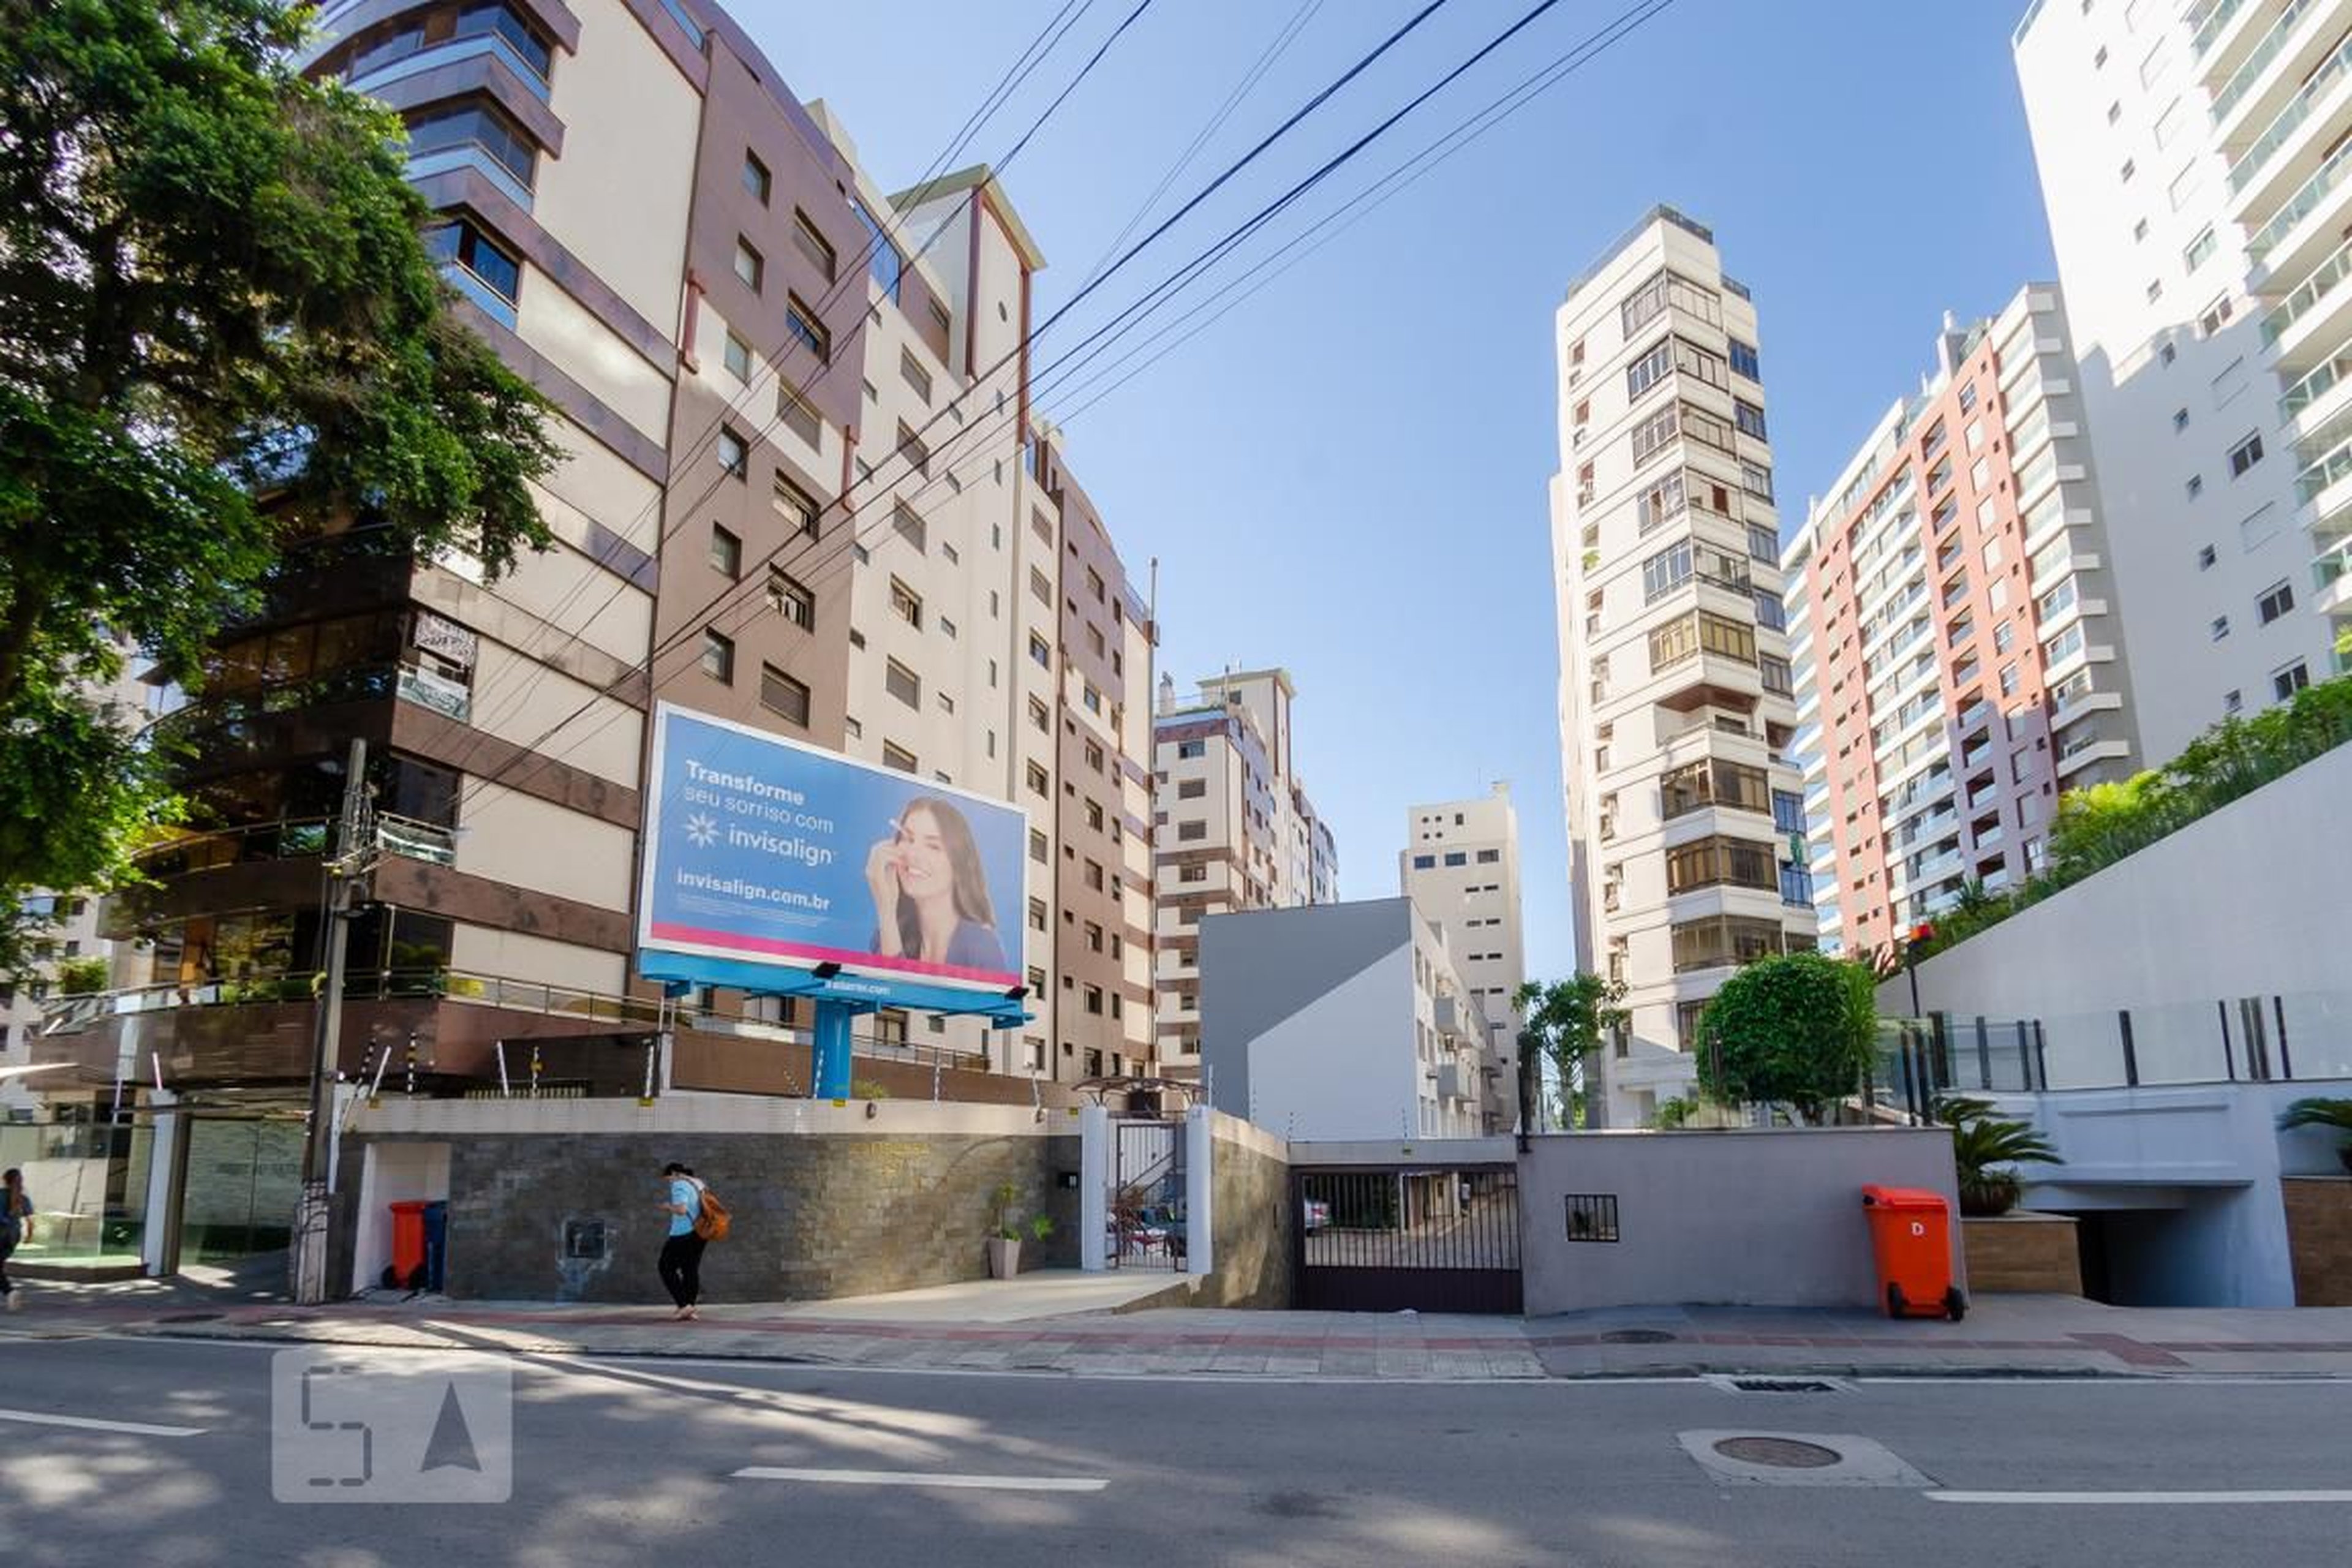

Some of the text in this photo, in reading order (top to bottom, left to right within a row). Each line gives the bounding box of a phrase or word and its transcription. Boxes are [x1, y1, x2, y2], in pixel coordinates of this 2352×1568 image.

[685, 759, 805, 805] Transforme
[685, 787, 834, 834] seu sorriso com
[728, 823, 832, 867] invisalign
[1911, 1222, 1924, 1235] D
